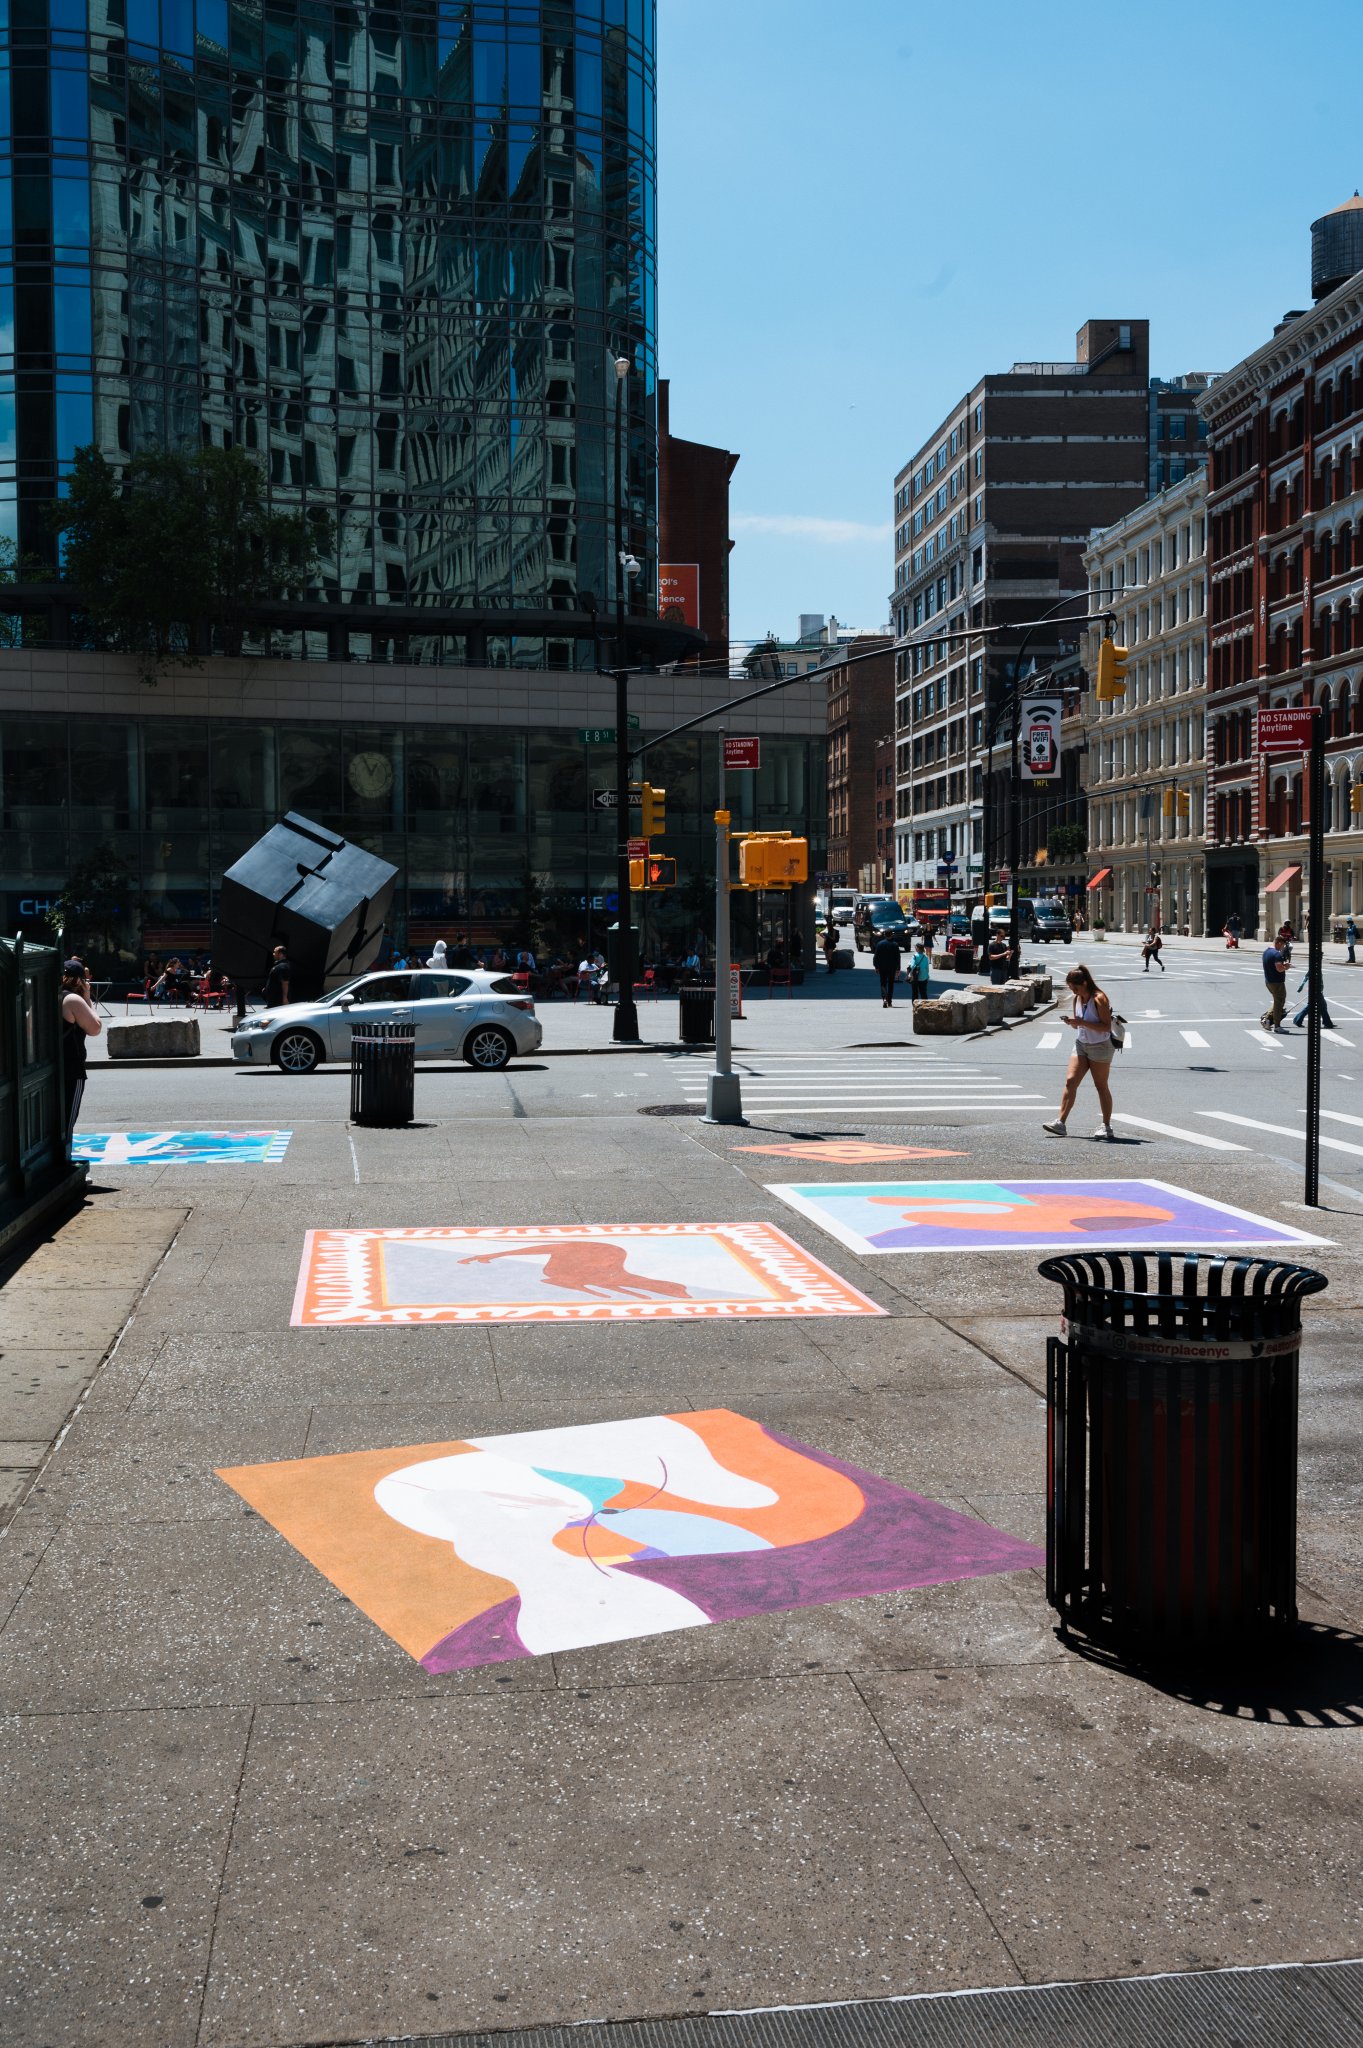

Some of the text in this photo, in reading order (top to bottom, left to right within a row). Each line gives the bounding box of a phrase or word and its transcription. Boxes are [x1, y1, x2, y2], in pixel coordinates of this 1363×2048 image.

[1260, 712, 1312, 723] NO STANDING
[1260, 723, 1294, 733] Anytime
[585, 730, 591, 742] E
[594, 730, 600, 742] 8
[725, 748, 744, 756] Anytime
[1032, 779, 1049, 787] TMPL
[602, 795, 618, 803] ONE
[1127, 1339, 1230, 1358] @astorplacenyc
